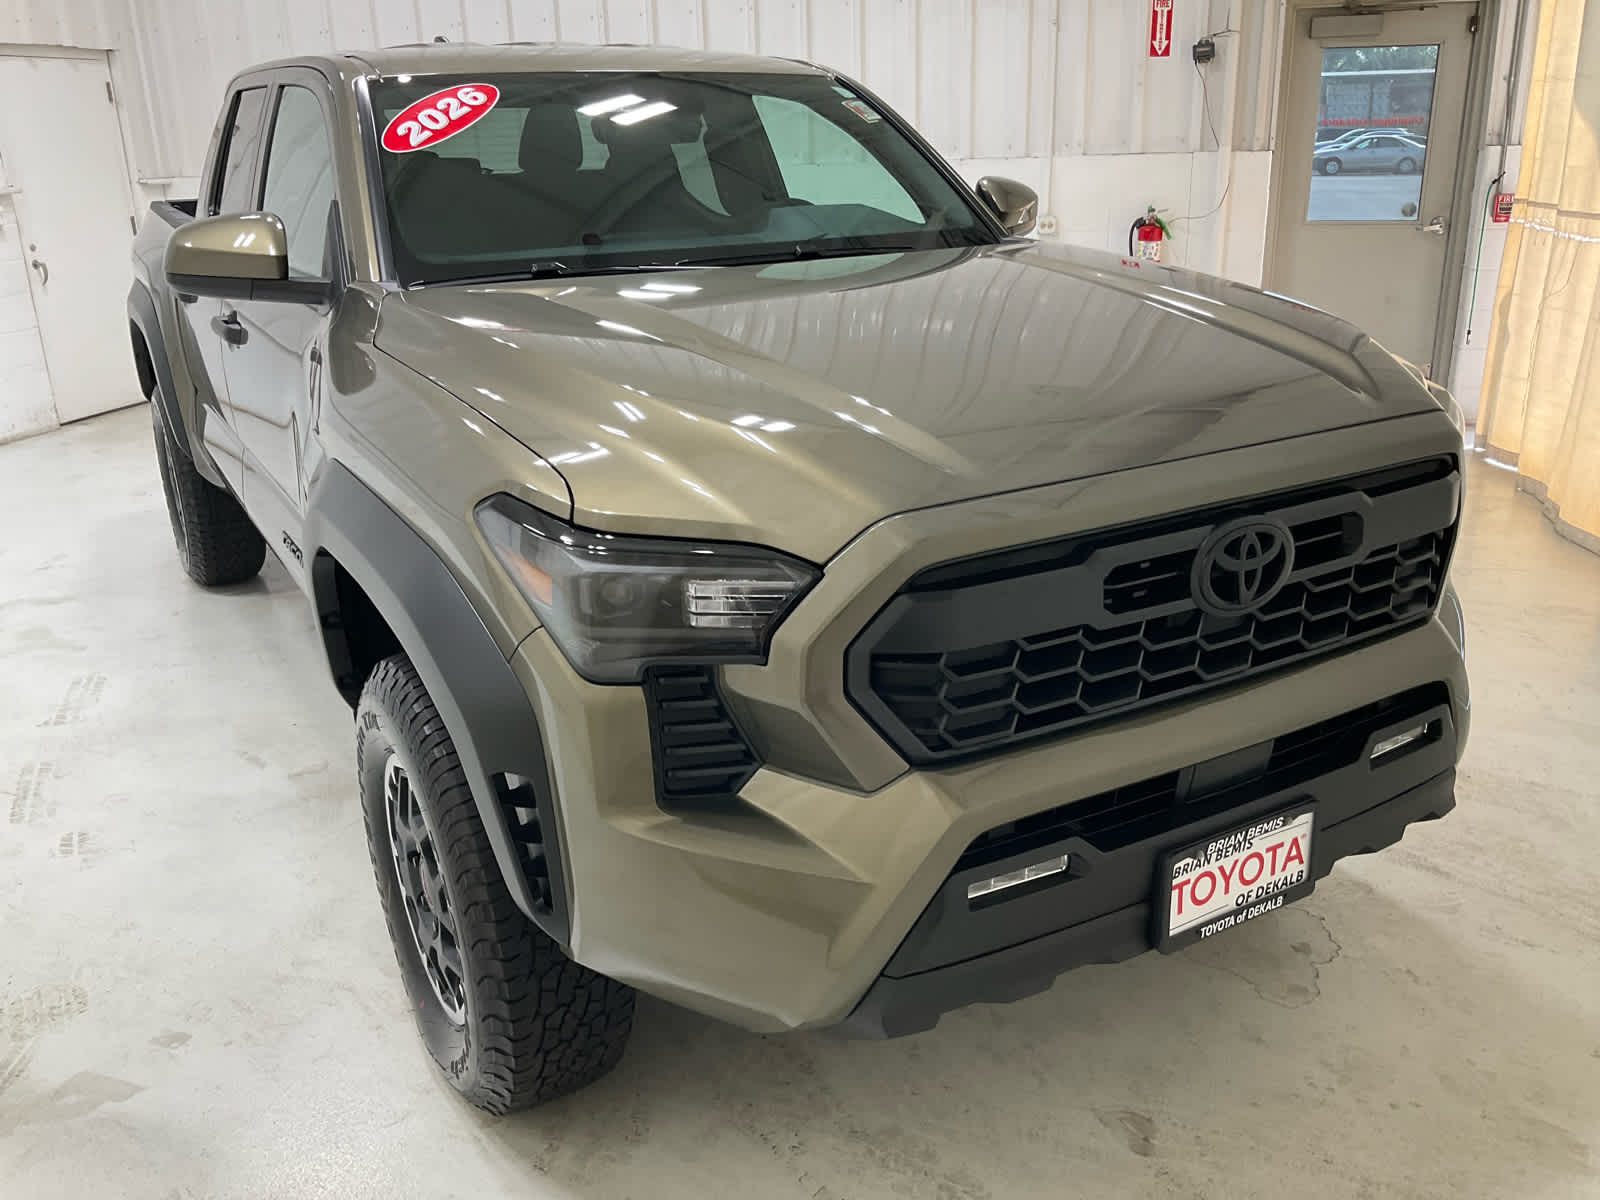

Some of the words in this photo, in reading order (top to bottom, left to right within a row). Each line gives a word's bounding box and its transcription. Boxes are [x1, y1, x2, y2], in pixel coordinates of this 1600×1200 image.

[396, 87, 488, 147] 2026
[1207, 831, 1246, 854] BRIAN
[1246, 816, 1285, 838] BEMIS
[1171, 836, 1305, 916] TOYOTA
[1173, 853, 1212, 879] BRIAN
[1215, 838, 1254, 862] BEMIS
[1235, 892, 1253, 907] OF
[1254, 869, 1304, 900] DEKALB
[1200, 916, 1236, 939] TOYOTA
[1236, 910, 1248, 923] of
[1247, 895, 1284, 919] DEKALB
